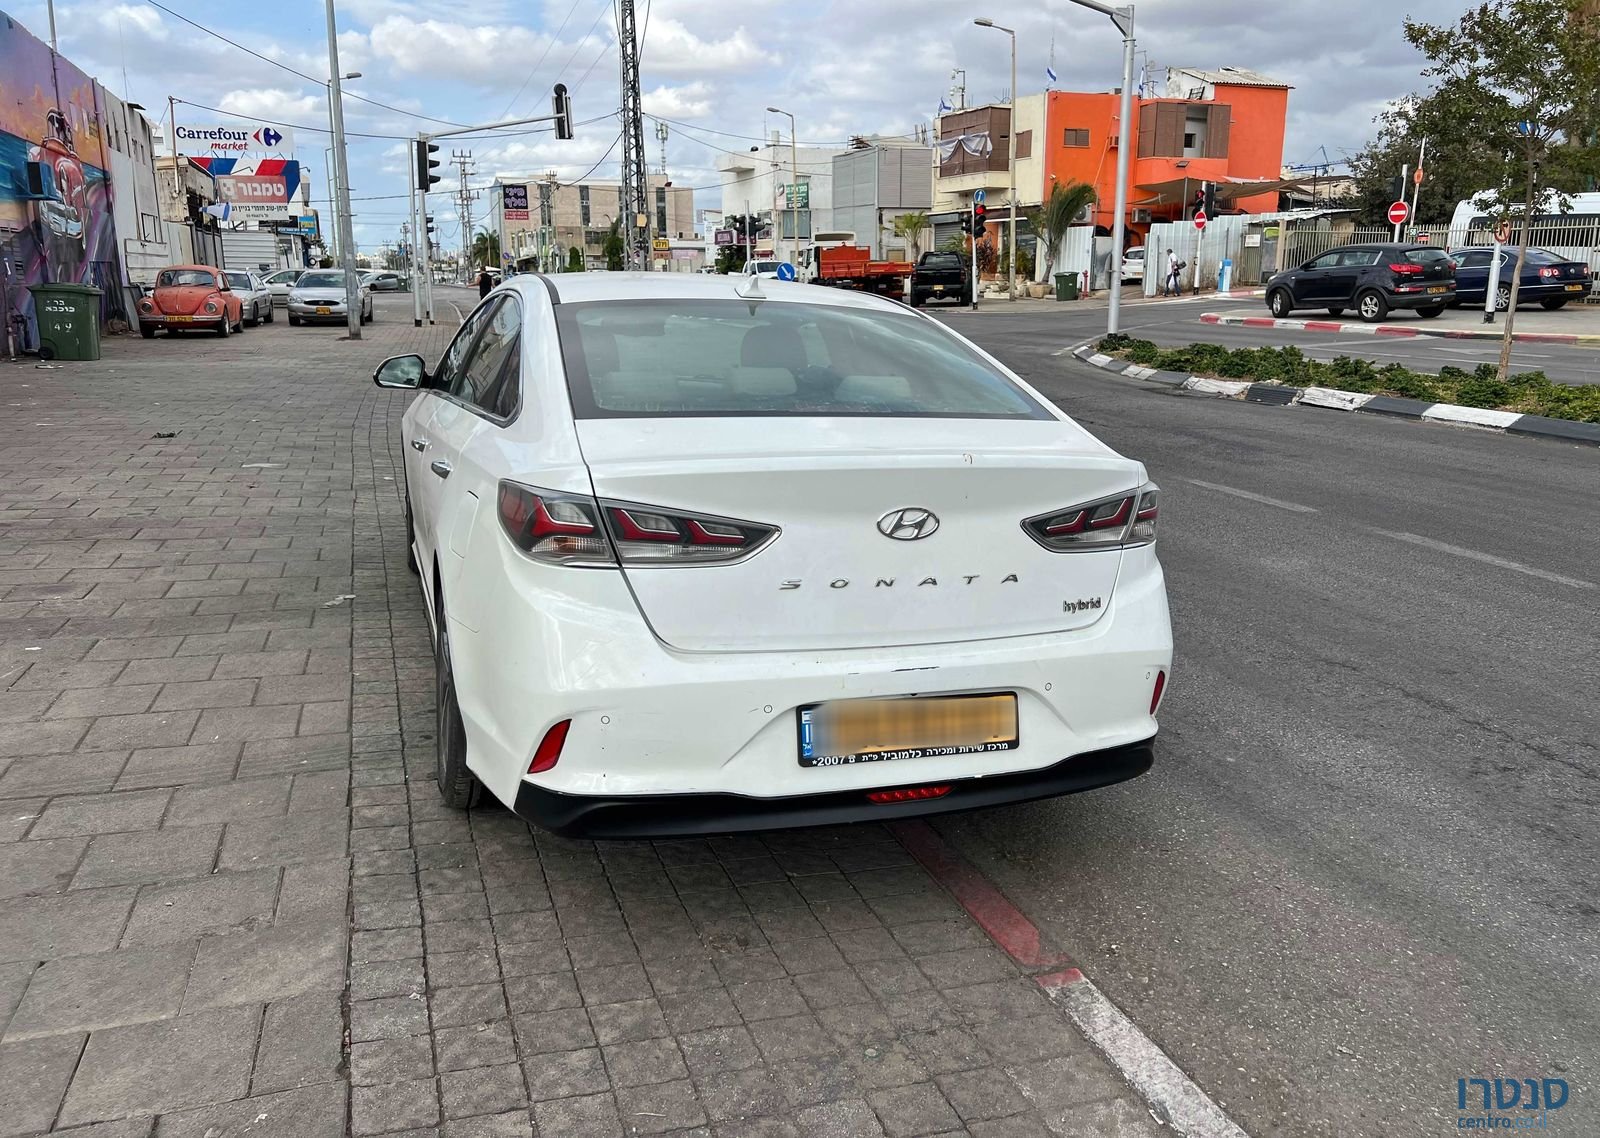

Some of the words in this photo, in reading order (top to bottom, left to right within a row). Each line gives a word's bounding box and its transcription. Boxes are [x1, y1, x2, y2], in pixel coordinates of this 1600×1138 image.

[176, 126, 248, 140] Carrefour
[210, 142, 248, 151] market
[237, 182, 285, 197] טמבור
[779, 574, 1019, 590] SONATA
[1062, 597, 1101, 614] hybrid
[926, 746, 956, 757] ומכירה
[959, 744, 984, 753] שירות
[987, 742, 1009, 751] מרכז
[881, 749, 922, 761] כלמוביל
